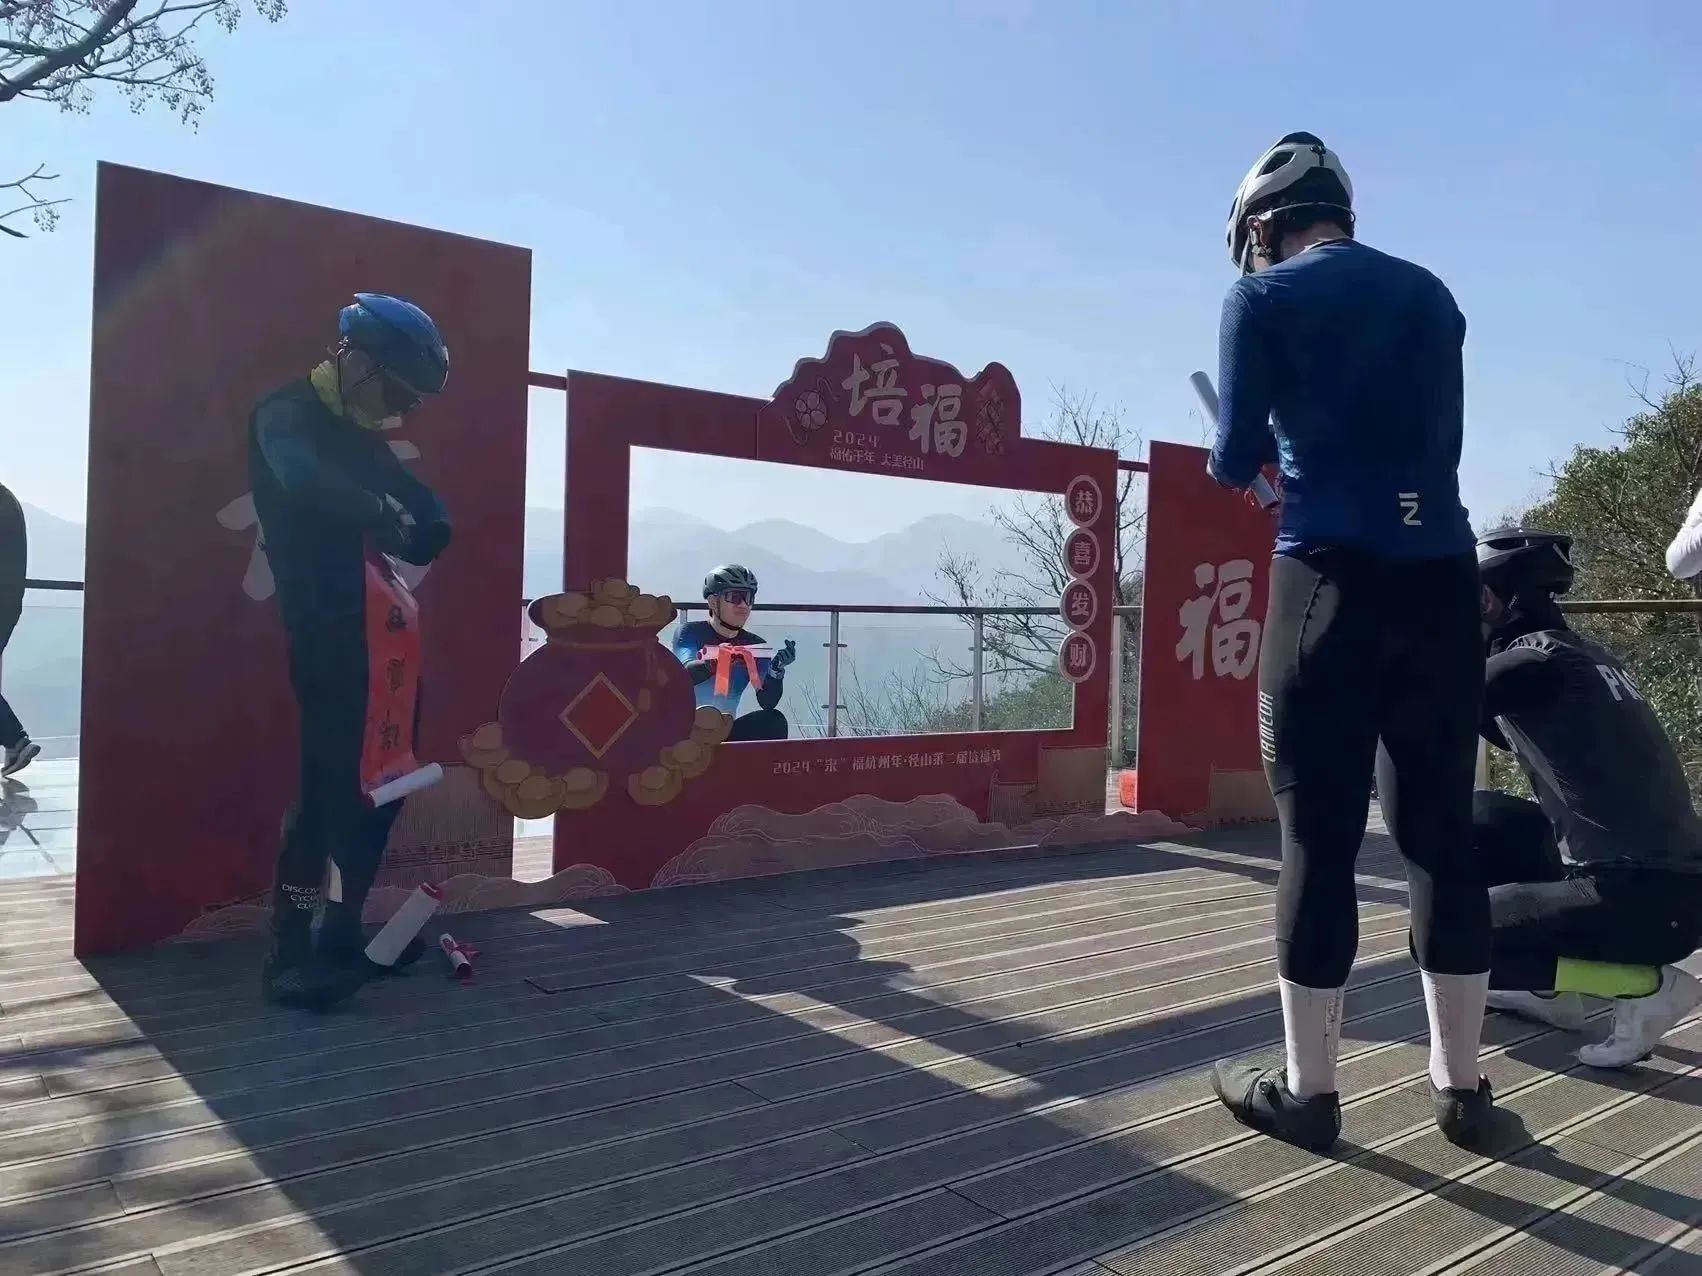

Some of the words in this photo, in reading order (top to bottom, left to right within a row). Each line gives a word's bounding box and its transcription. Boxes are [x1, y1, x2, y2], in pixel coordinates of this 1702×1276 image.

[833, 429, 879, 447] 2024
[842, 342, 968, 457] 培福
[1069, 490, 1094, 667] 恭喜发财
[1176, 559, 1261, 680] 福
